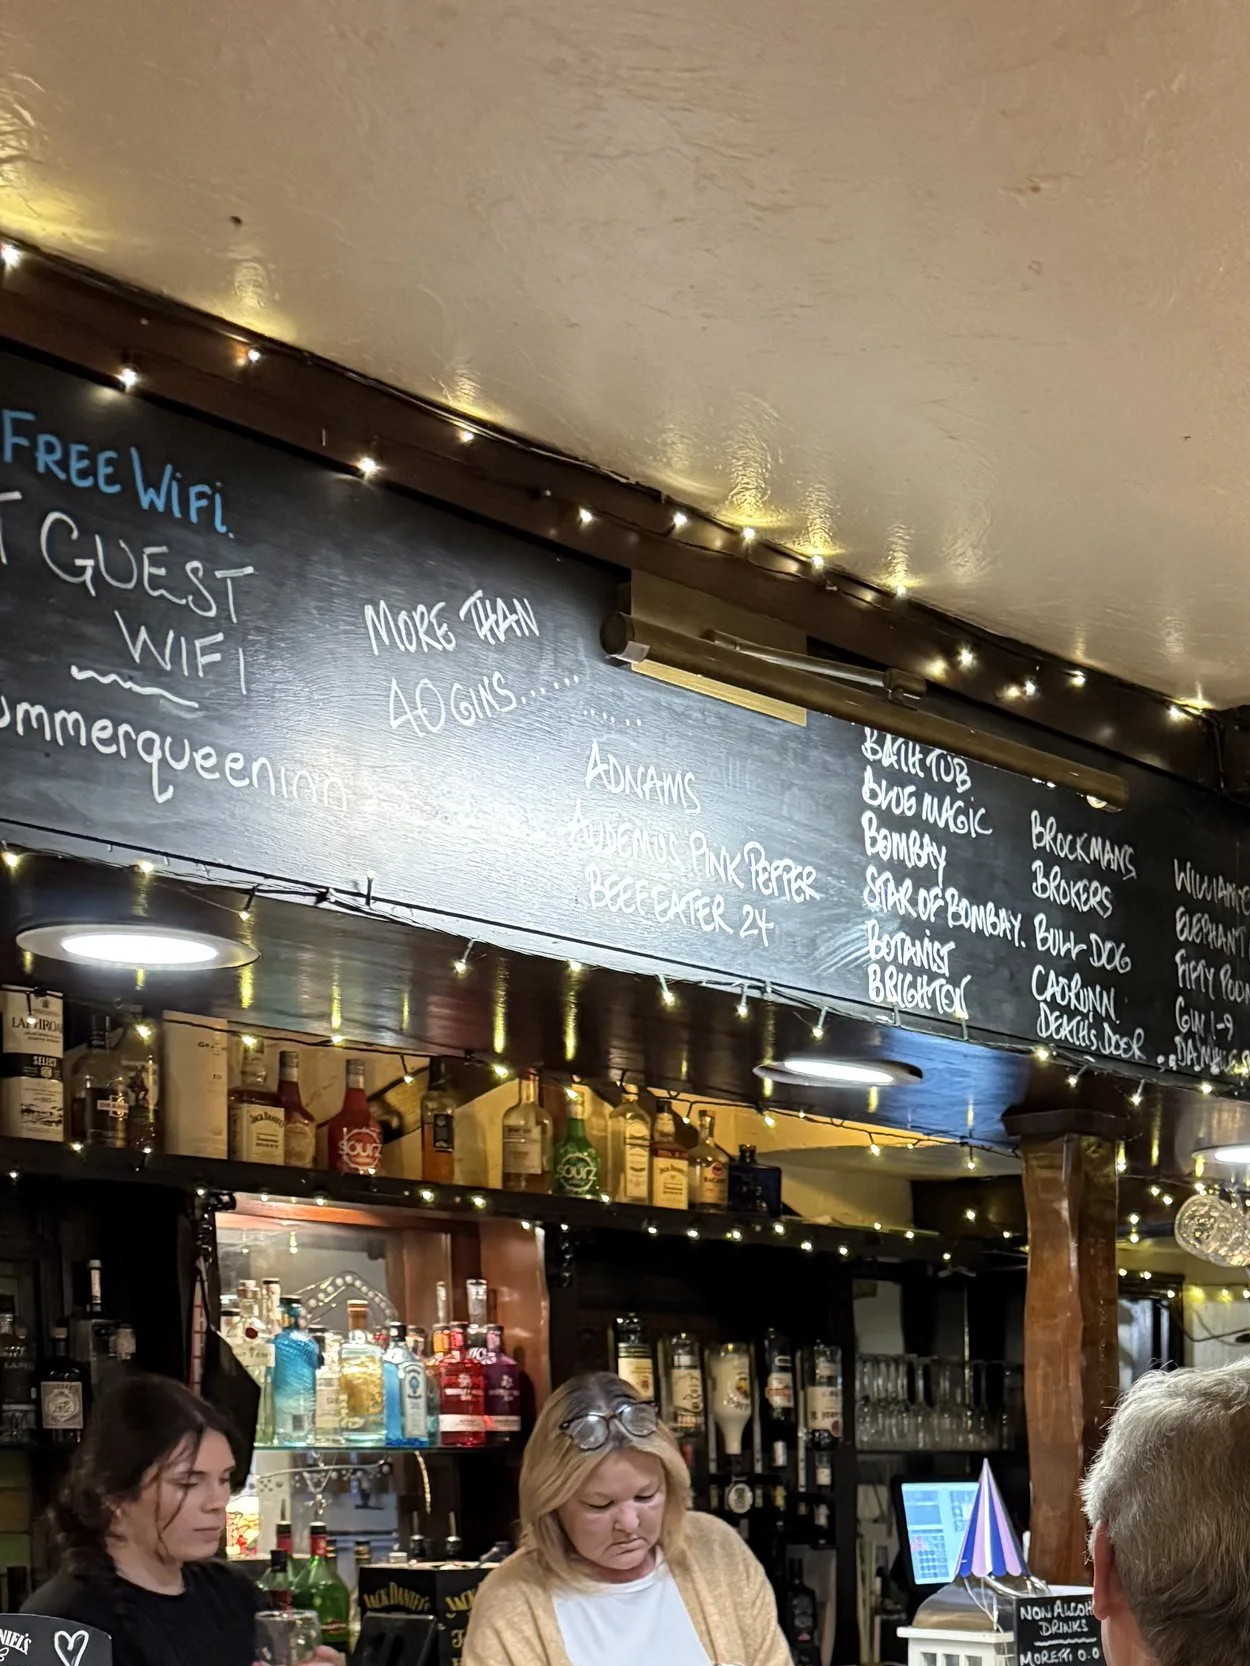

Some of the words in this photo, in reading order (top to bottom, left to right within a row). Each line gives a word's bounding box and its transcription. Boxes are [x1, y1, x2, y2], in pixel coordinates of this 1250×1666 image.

[3, 409, 123, 494] FREE
[40, 511, 255, 624] GUEST
[364, 600, 457, 655] MORE
[459, 589, 540, 645] THAN
[114, 609, 247, 695] WIFI
[585, 741, 702, 815] ADNAMS
[861, 765, 917, 817] BLUE
[689, 830, 745, 890] PINK
[743, 840, 821, 904] PEPPER
[861, 810, 947, 890] BOMBAY
[863, 864, 918, 919] STAR
[917, 886, 945, 923] OF
[1031, 859, 1114, 920] BROKERS
[739, 903, 775, 948] 24
[1089, 932, 1132, 974] DOG
[867, 962, 973, 1021] BRIGHTON
[1174, 947, 1215, 1001] FIFTY
[1099, 1021, 1147, 1060] DOOR
[1020, 1605, 1052, 1622] NON
[1039, 1619, 1090, 1637] DRINKS
[1077, 1647, 1101, 1662] 0.0
